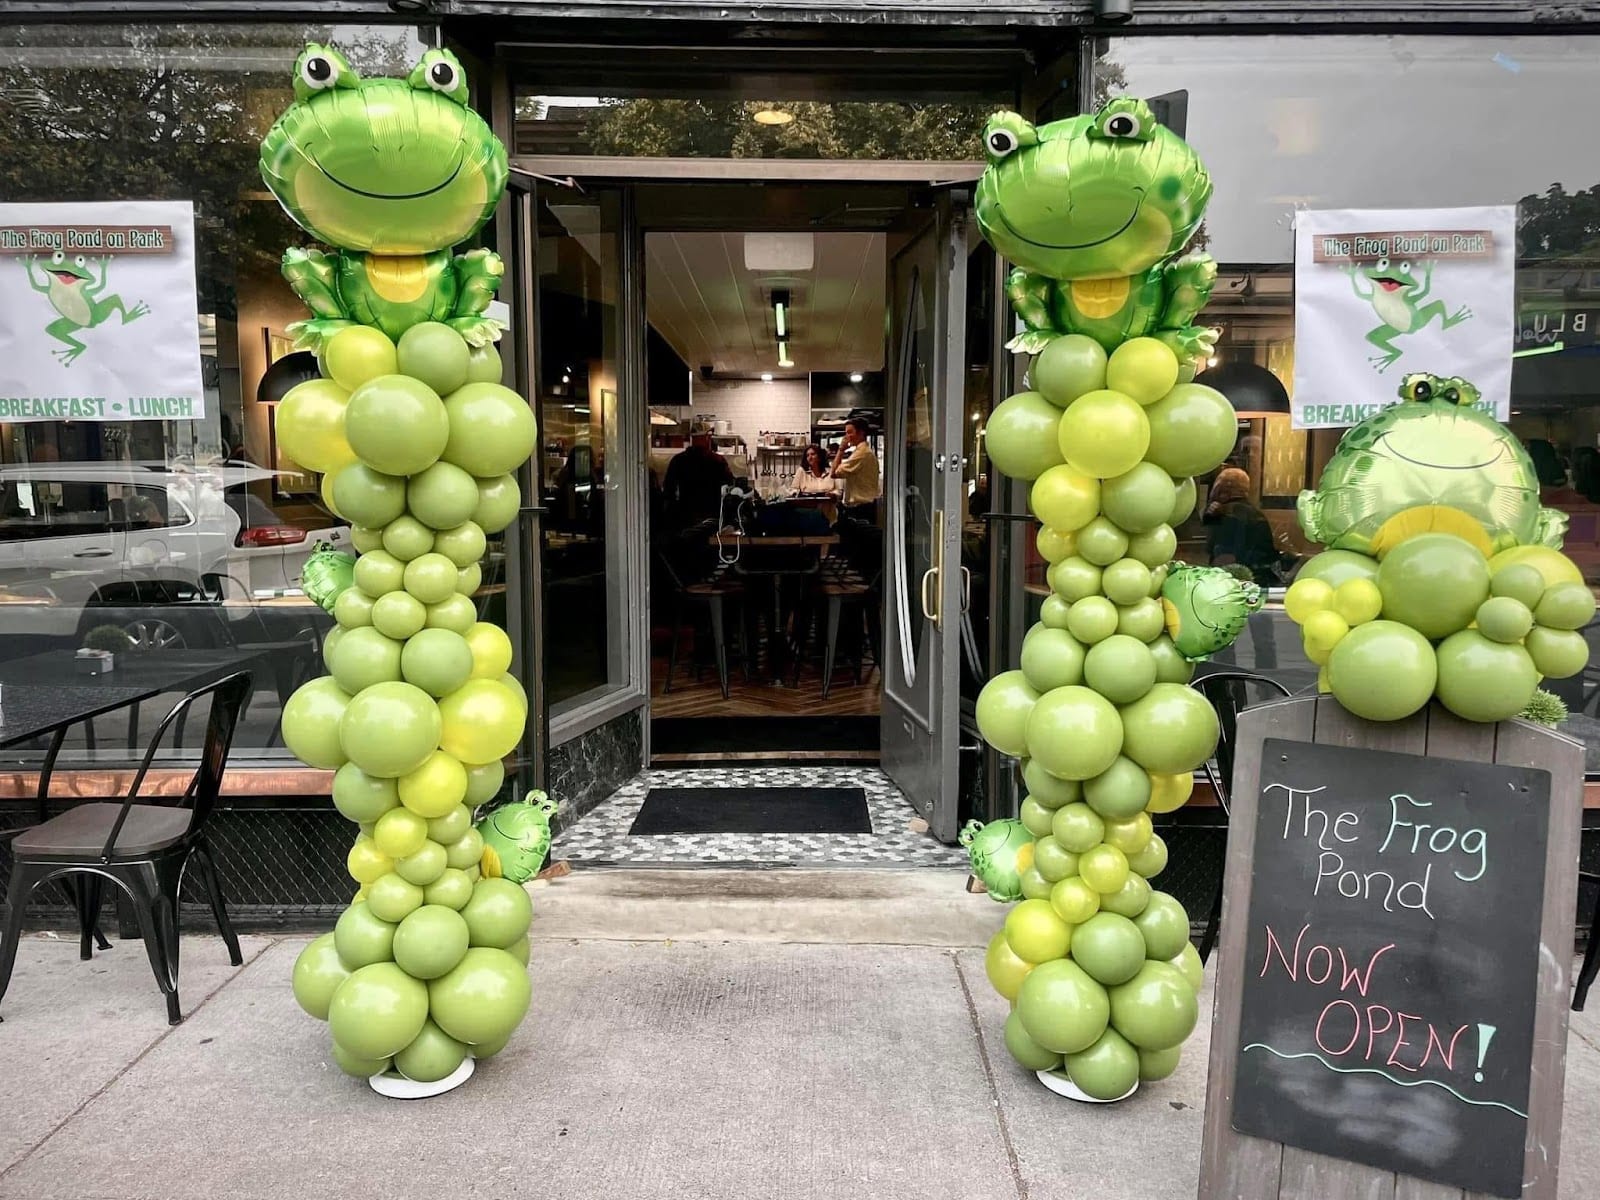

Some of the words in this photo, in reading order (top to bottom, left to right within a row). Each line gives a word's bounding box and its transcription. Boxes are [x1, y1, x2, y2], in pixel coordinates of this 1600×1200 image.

[1, 230, 25, 247] The
[30, 229, 62, 249] Frog
[67, 230, 102, 248] Pond
[107, 234, 125, 247] on
[130, 230, 164, 248] Park
[1323, 238, 1349, 256] The
[1354, 236, 1388, 257] Frog
[1393, 234, 1428, 254] Pond
[1432, 237, 1448, 252] on
[1453, 232, 1485, 252] Park
[0, 397, 105, 417] BREAKFAST
[129, 396, 192, 416] LUNCH
[1303, 402, 1392, 424] BREAKF
[1263, 783, 1359, 850] The
[1378, 794, 1487, 882] Frog
[1314, 851, 1434, 920] Pond
